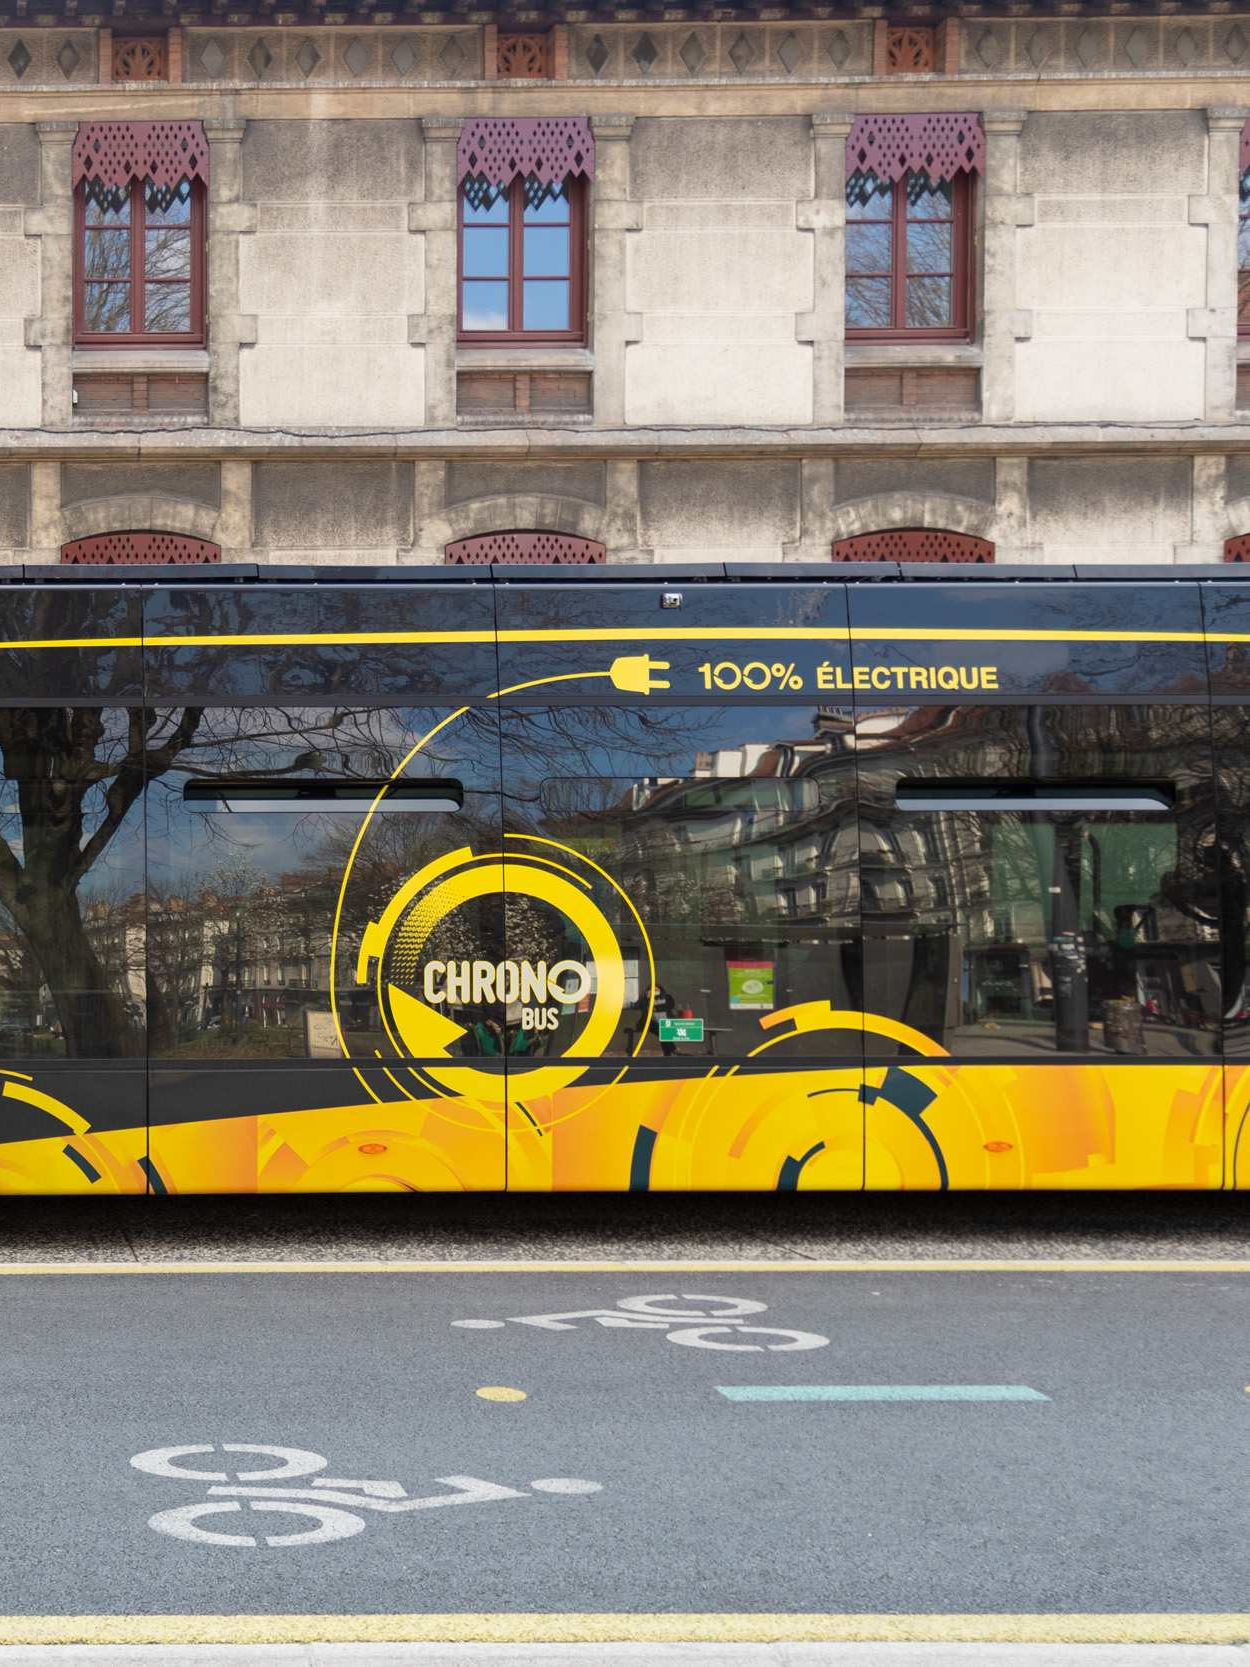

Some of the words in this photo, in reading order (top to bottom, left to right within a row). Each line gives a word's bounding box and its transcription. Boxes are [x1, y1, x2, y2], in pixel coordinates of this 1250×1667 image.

[698, 661, 803, 690] 100%
[816, 661, 999, 690] ÉLECTRIQUE
[424, 960, 591, 1004] CHRONO
[521, 1007, 559, 1031] BUS
